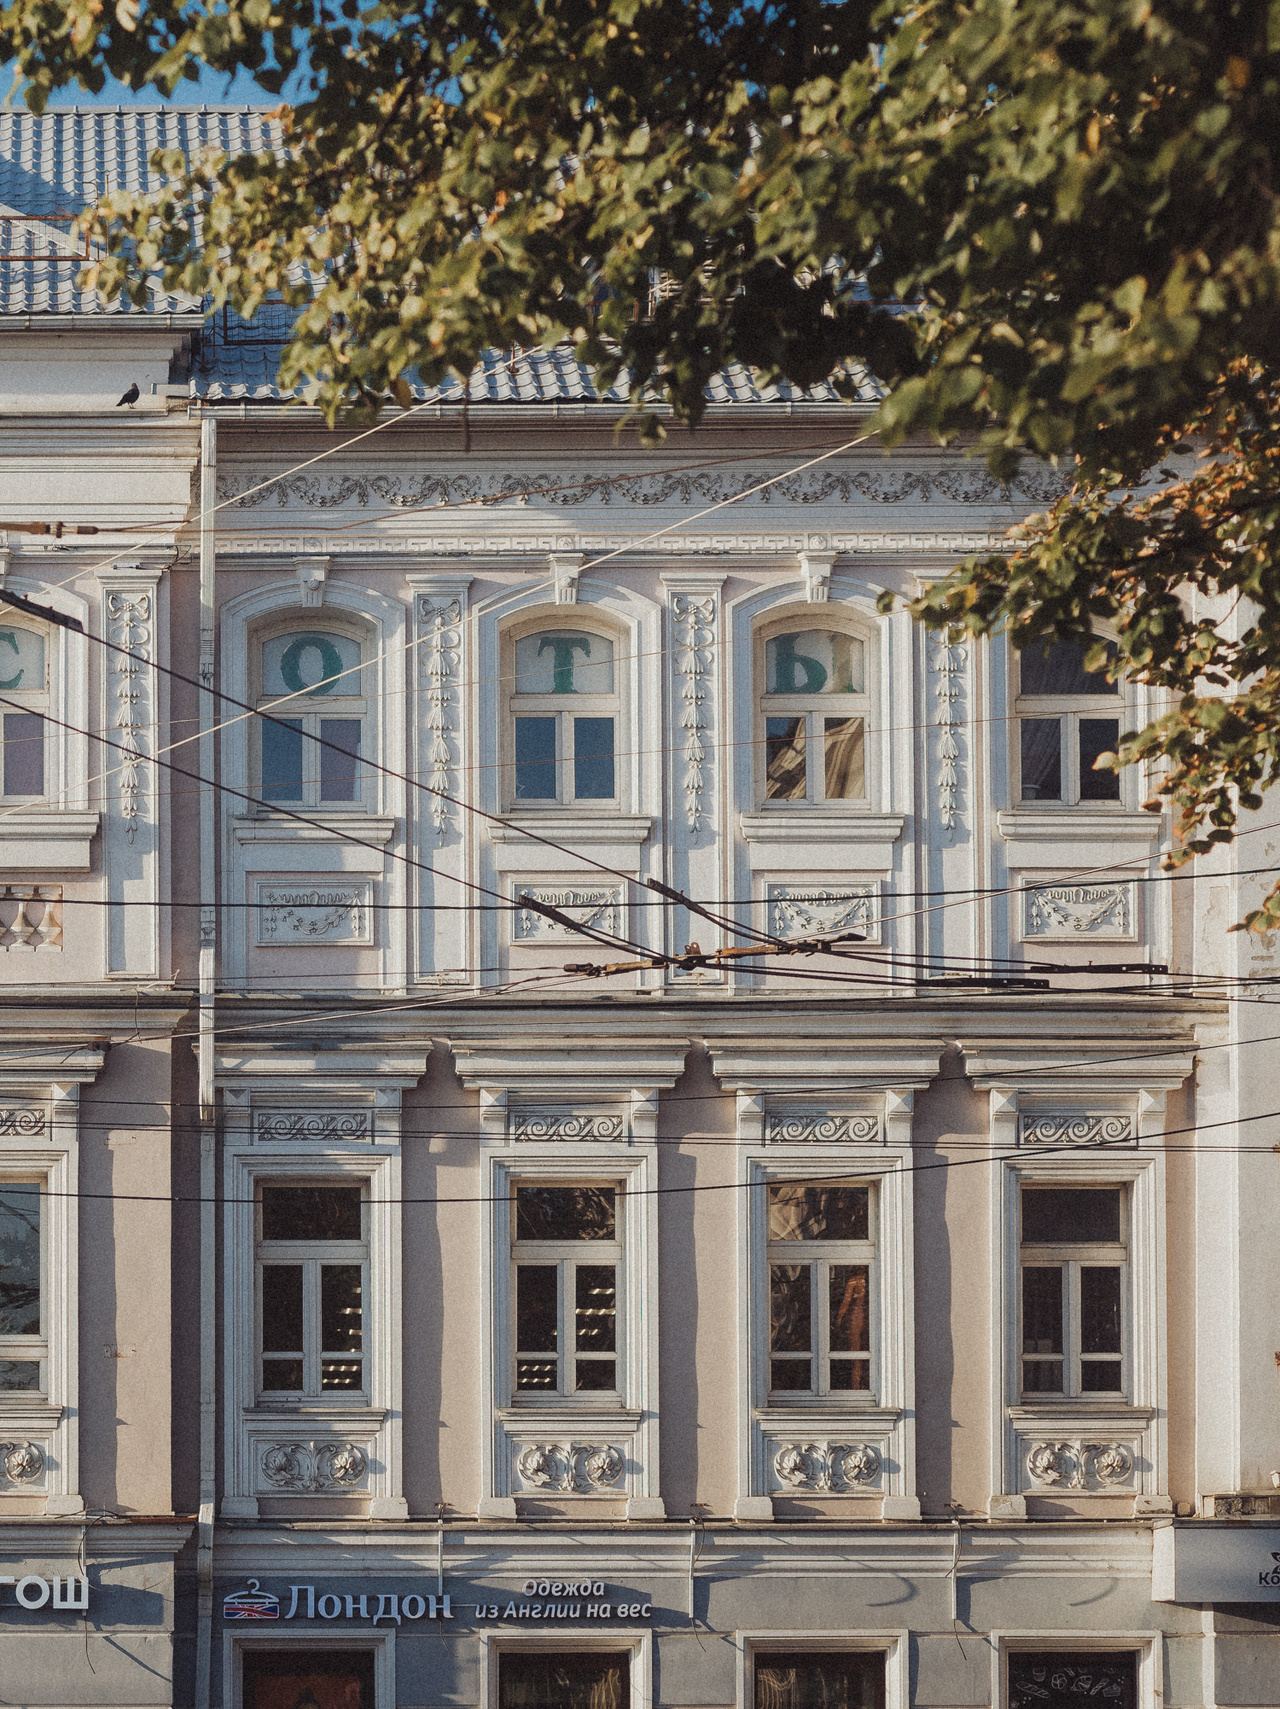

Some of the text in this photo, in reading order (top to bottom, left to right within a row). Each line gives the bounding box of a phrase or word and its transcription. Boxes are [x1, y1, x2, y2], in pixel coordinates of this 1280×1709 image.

[522, 1577, 605, 1597] Одежда
[284, 1585, 454, 1626] Лондон
[474, 1600, 653, 1619] из Англии на вес
